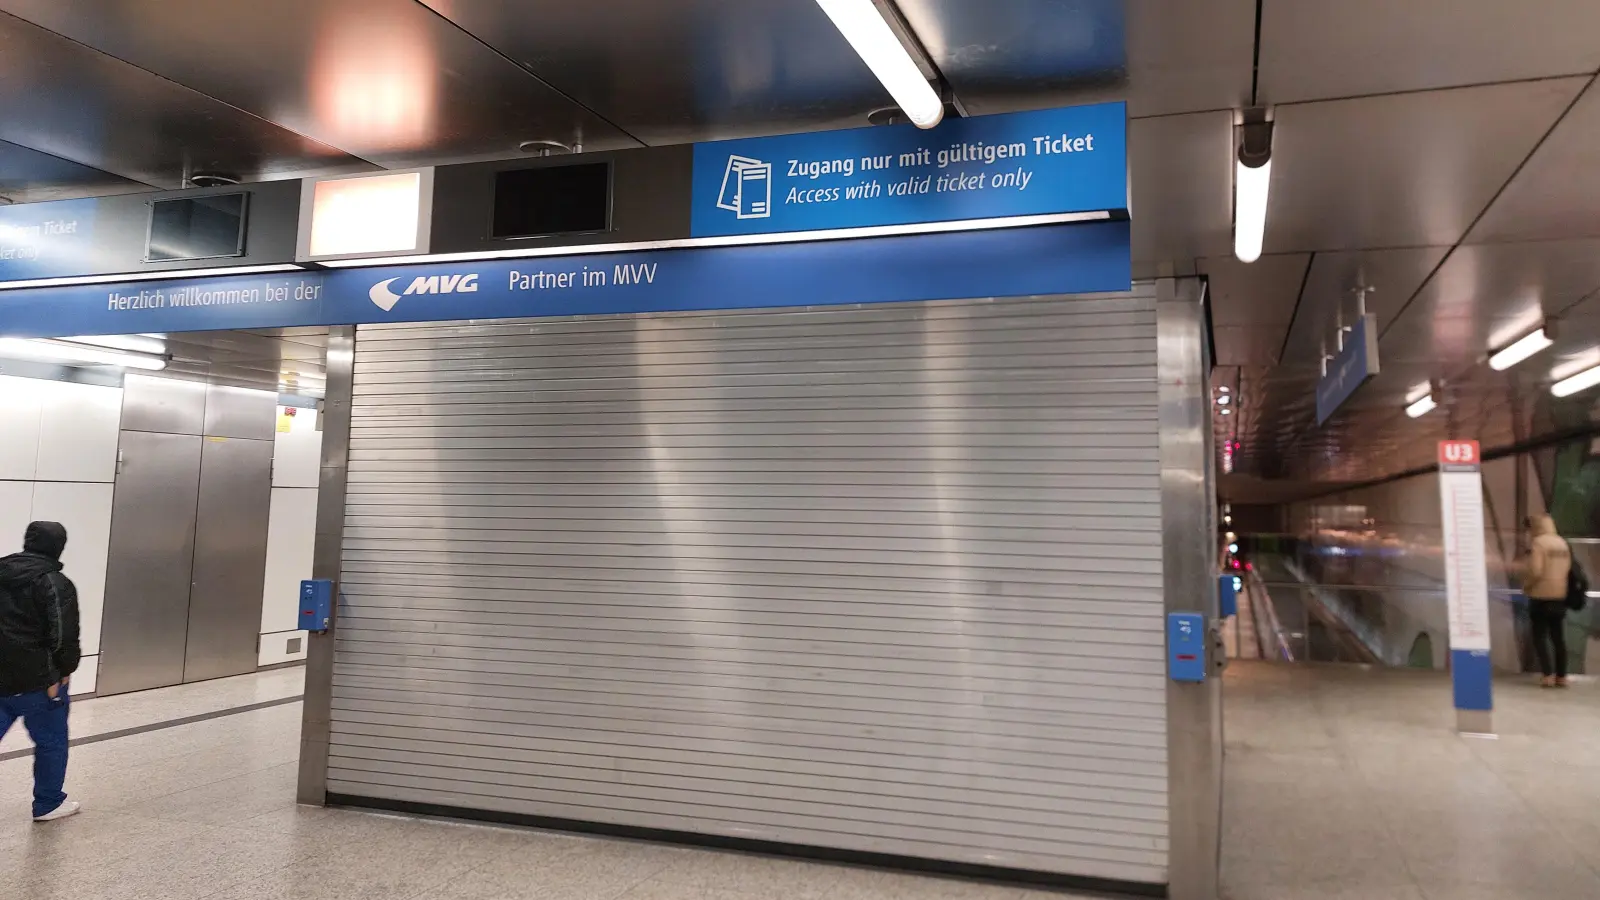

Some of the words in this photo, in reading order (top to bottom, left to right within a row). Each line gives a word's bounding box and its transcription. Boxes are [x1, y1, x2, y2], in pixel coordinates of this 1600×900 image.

[787, 158, 855, 178] Zugang
[861, 155, 892, 172] nur
[899, 148, 931, 168] mit
[938, 141, 1026, 168] gültigem
[1033, 133, 1094, 154] Ticket
[785, 185, 840, 204] Access
[845, 180, 882, 200] with
[887, 174, 930, 196] valid
[936, 174, 986, 192] ticket
[991, 168, 1033, 191] only
[43, 220, 77, 235] Ticket
[403, 274, 479, 294] MVG
[509, 271, 576, 290] Partner
[583, 266, 606, 286] im
[613, 263, 658, 285] MVV
[108, 288, 165, 311] Herzlich
[169, 283, 259, 306] willkommen
[265, 282, 289, 302] bei
[294, 281, 321, 300] der
[1445, 443, 1472, 461] U3
